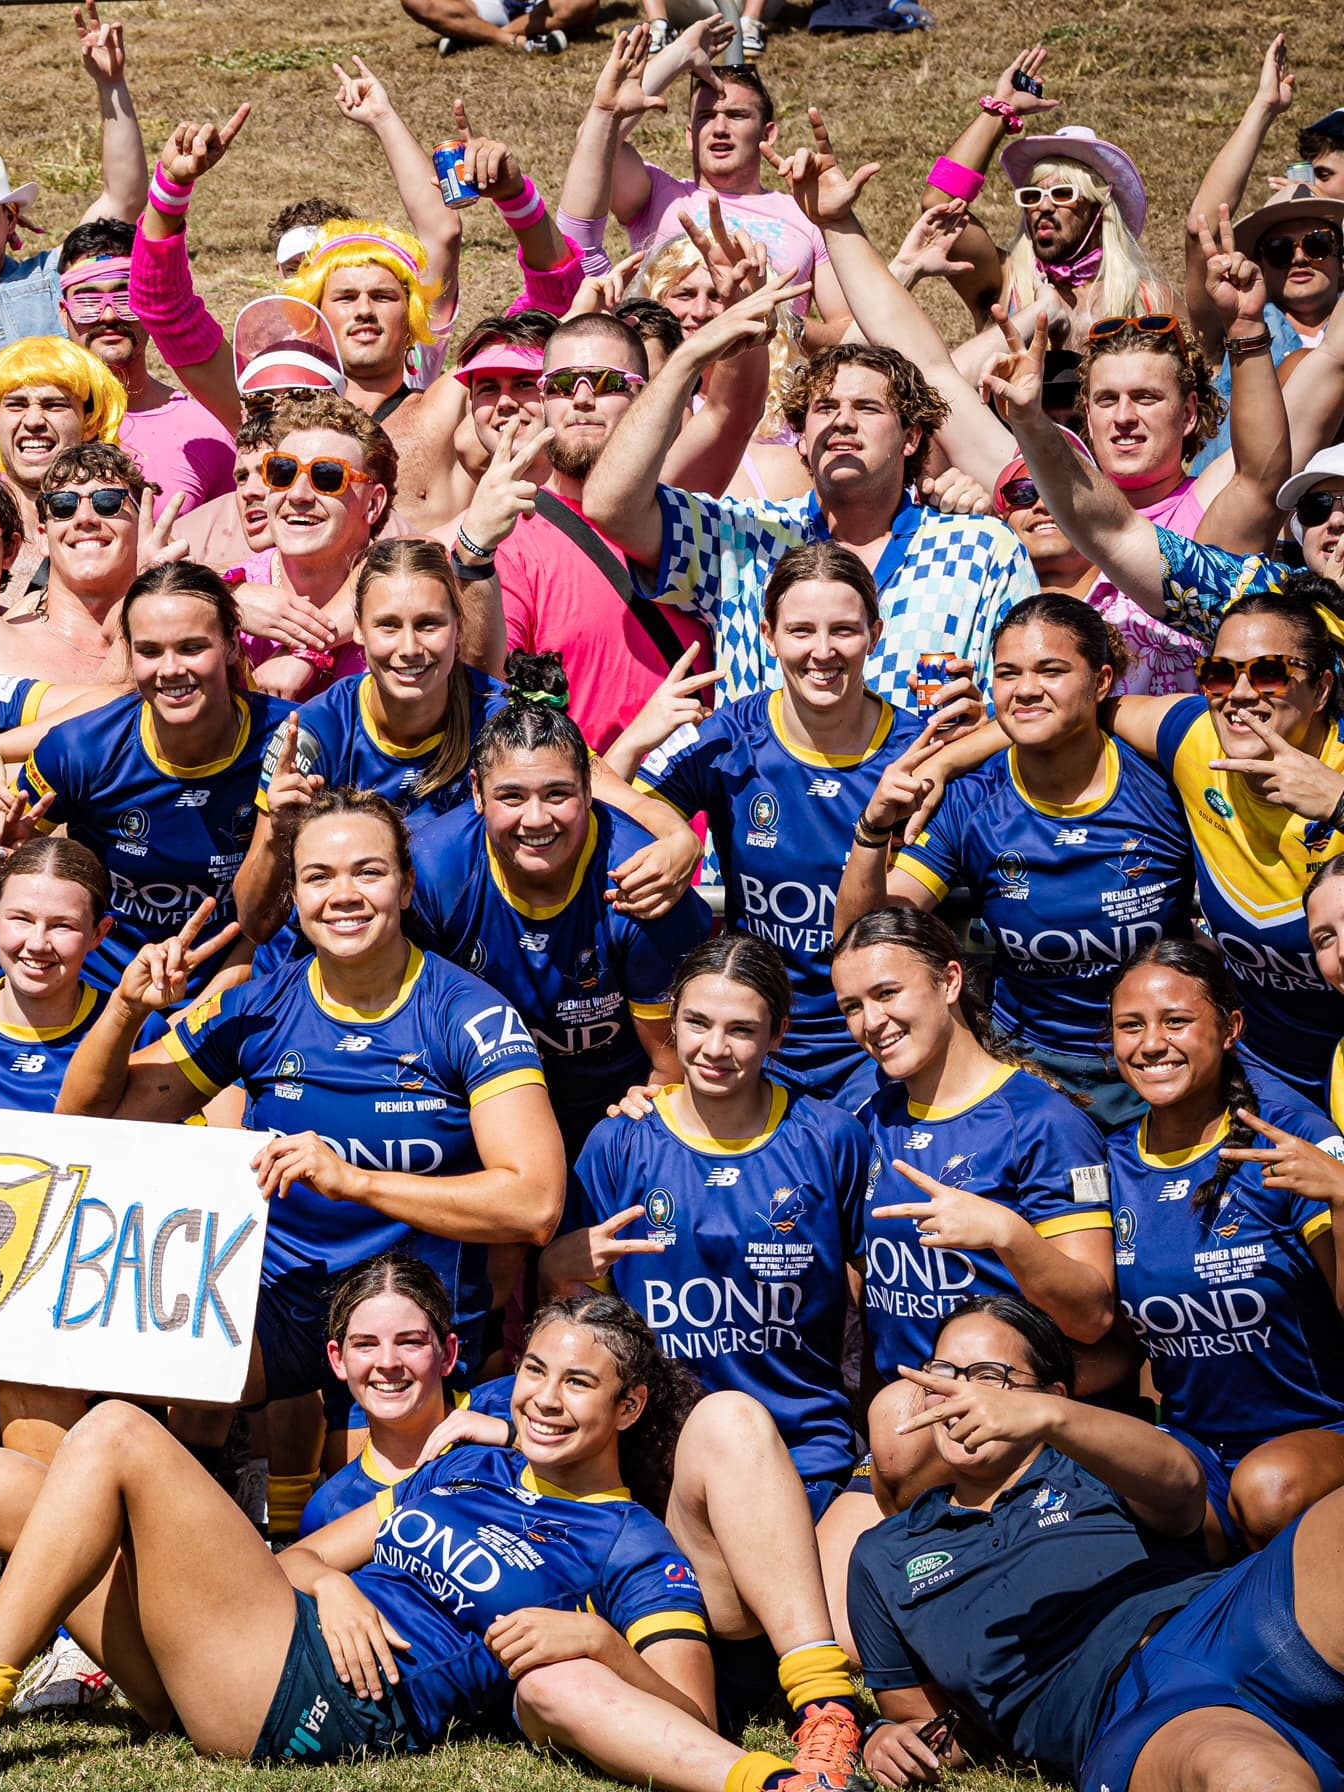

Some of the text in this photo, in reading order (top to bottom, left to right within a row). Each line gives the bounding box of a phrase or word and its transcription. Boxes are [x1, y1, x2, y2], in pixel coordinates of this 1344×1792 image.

[116, 844, 148, 857] RUGBY
[746, 837, 777, 848] RUGBY
[210, 852, 244, 865] PREMIER
[739, 873, 837, 926] BON
[1101, 888, 1137, 904] PREMIER
[1138, 882, 1167, 895] WOMEN
[746, 914, 834, 952] UNIVER
[999, 921, 1163, 963] BOND
[557, 999, 591, 1012] PREMIER
[592, 991, 621, 1008] WOMEN
[527, 1021, 621, 1053] ND
[275, 1089, 303, 1101] RUGBY
[375, 1098, 447, 1113] PREMIER WOMEN
[748, 1242, 813, 1255] PREMIER WOMEN
[1194, 1243, 1264, 1265] PREMIER WOMEN
[51, 1198, 259, 1348] BACK
[644, 1276, 803, 1329] BOND
[1038, 1511, 1071, 1528] RUGBY
[485, 1524, 520, 1543] PREMIER
[515, 1537, 545, 1567] WOMEN
[374, 1543, 475, 1615] NIVERSITY
[928, 1569, 956, 1585] COAST
[305, 1694, 329, 1735] SEA
